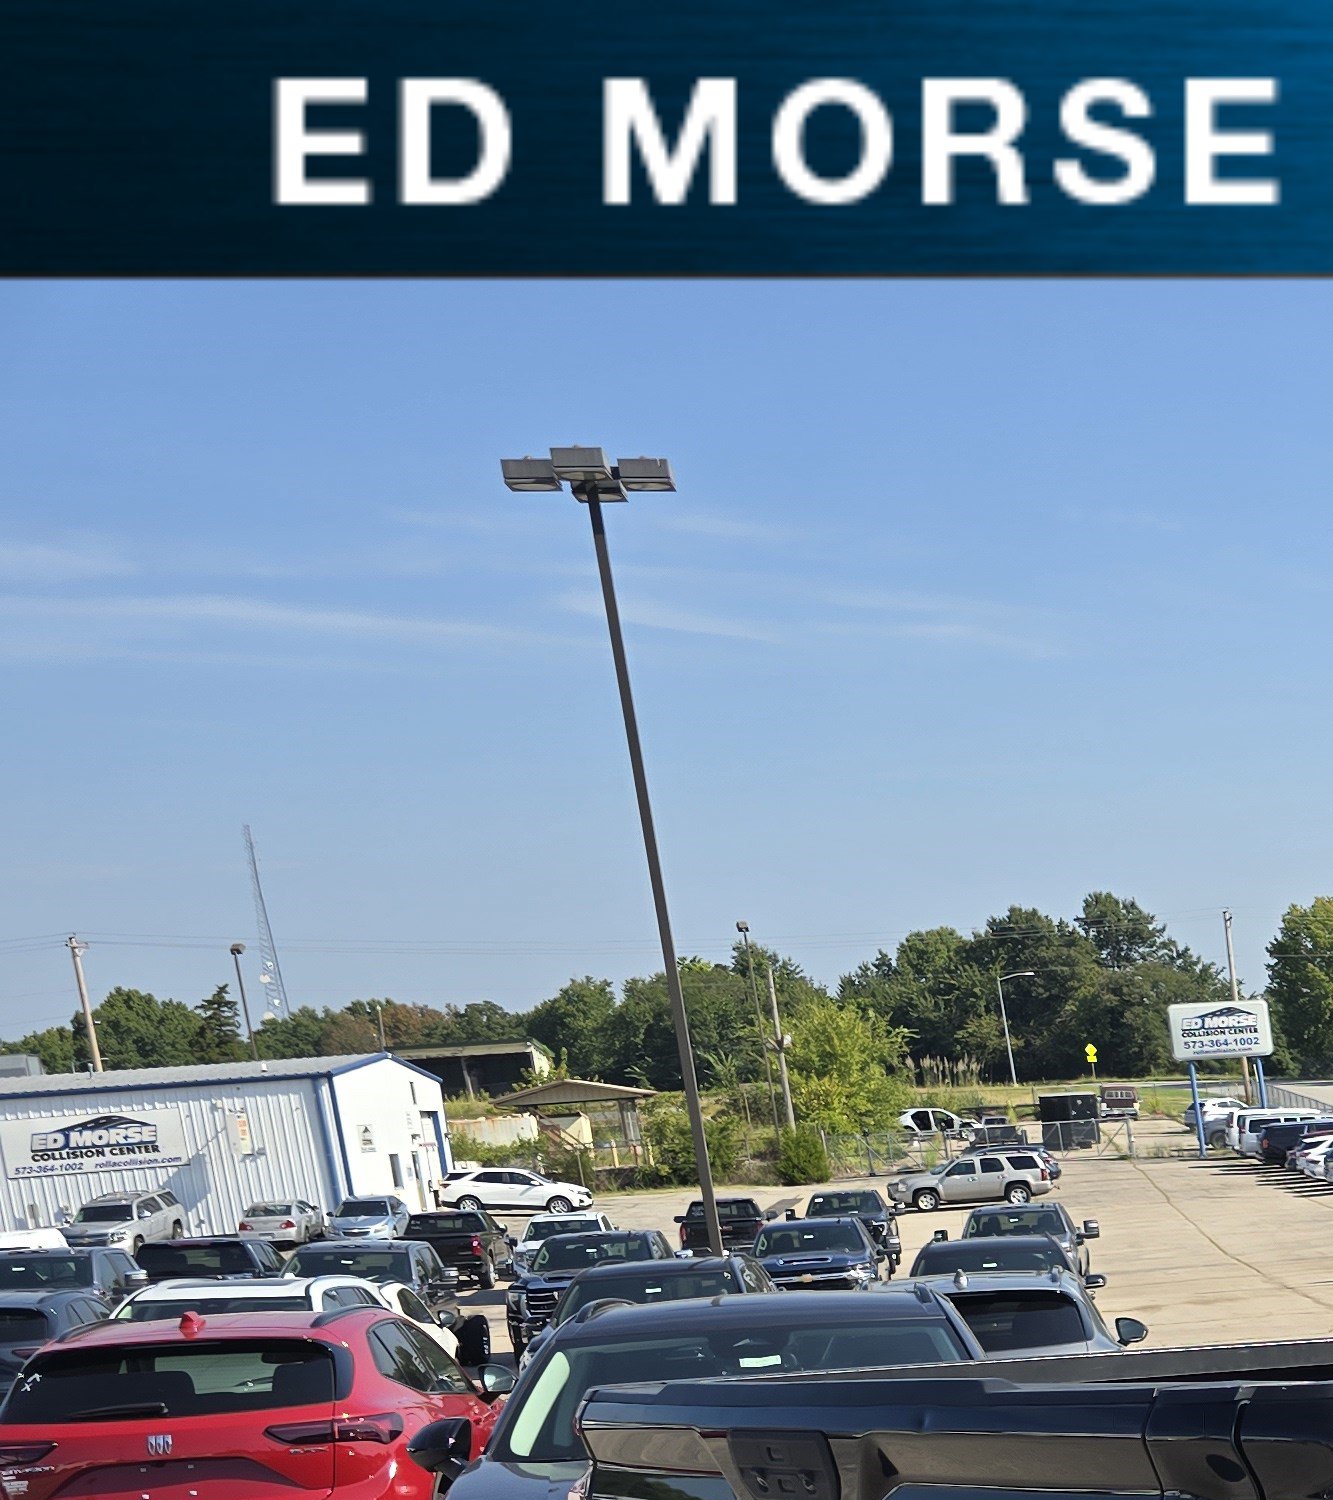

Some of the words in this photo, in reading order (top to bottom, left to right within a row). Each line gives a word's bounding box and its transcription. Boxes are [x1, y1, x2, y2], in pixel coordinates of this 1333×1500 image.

[1182, 1018, 1202, 1030] ED
[1204, 1014, 1257, 1028] MORSE
[1181, 1029, 1226, 1038] COLLISION
[1184, 1037, 1260, 1049] 573-364-1002
[31, 1133, 66, 1151] ED
[68, 1125, 156, 1149] MORSE
[31, 1149, 106, 1162] COLLISION
[109, 1144, 161, 1156] CENTER
[14, 1162, 84, 1175] 573-364-1002
[94, 1156, 182, 1169] rollacollision.com
